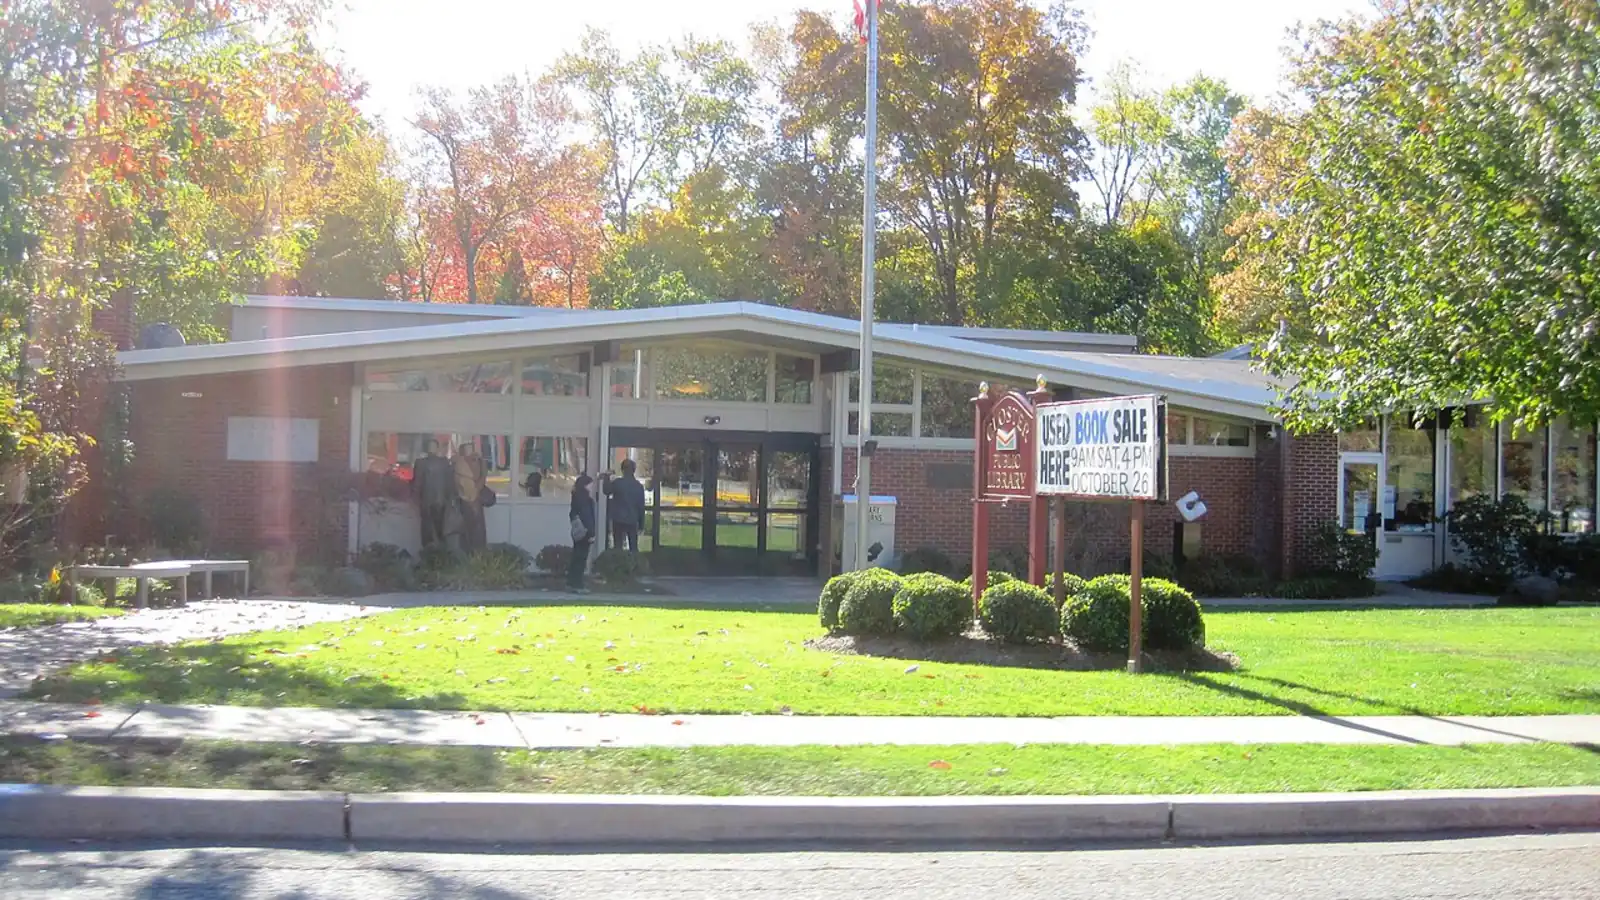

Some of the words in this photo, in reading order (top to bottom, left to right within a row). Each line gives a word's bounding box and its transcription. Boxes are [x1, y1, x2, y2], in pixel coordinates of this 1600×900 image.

[1042, 413, 1071, 446] USED
[1075, 410, 1109, 445] BOOK
[1113, 408, 1147, 443] SALE
[992, 453, 1021, 469] PUBLIC
[1040, 449, 1070, 485] HERE
[987, 471, 1027, 490] LIBRARY
[1072, 471, 1130, 494] OCTOBER
[1132, 470, 1149, 494] 26
